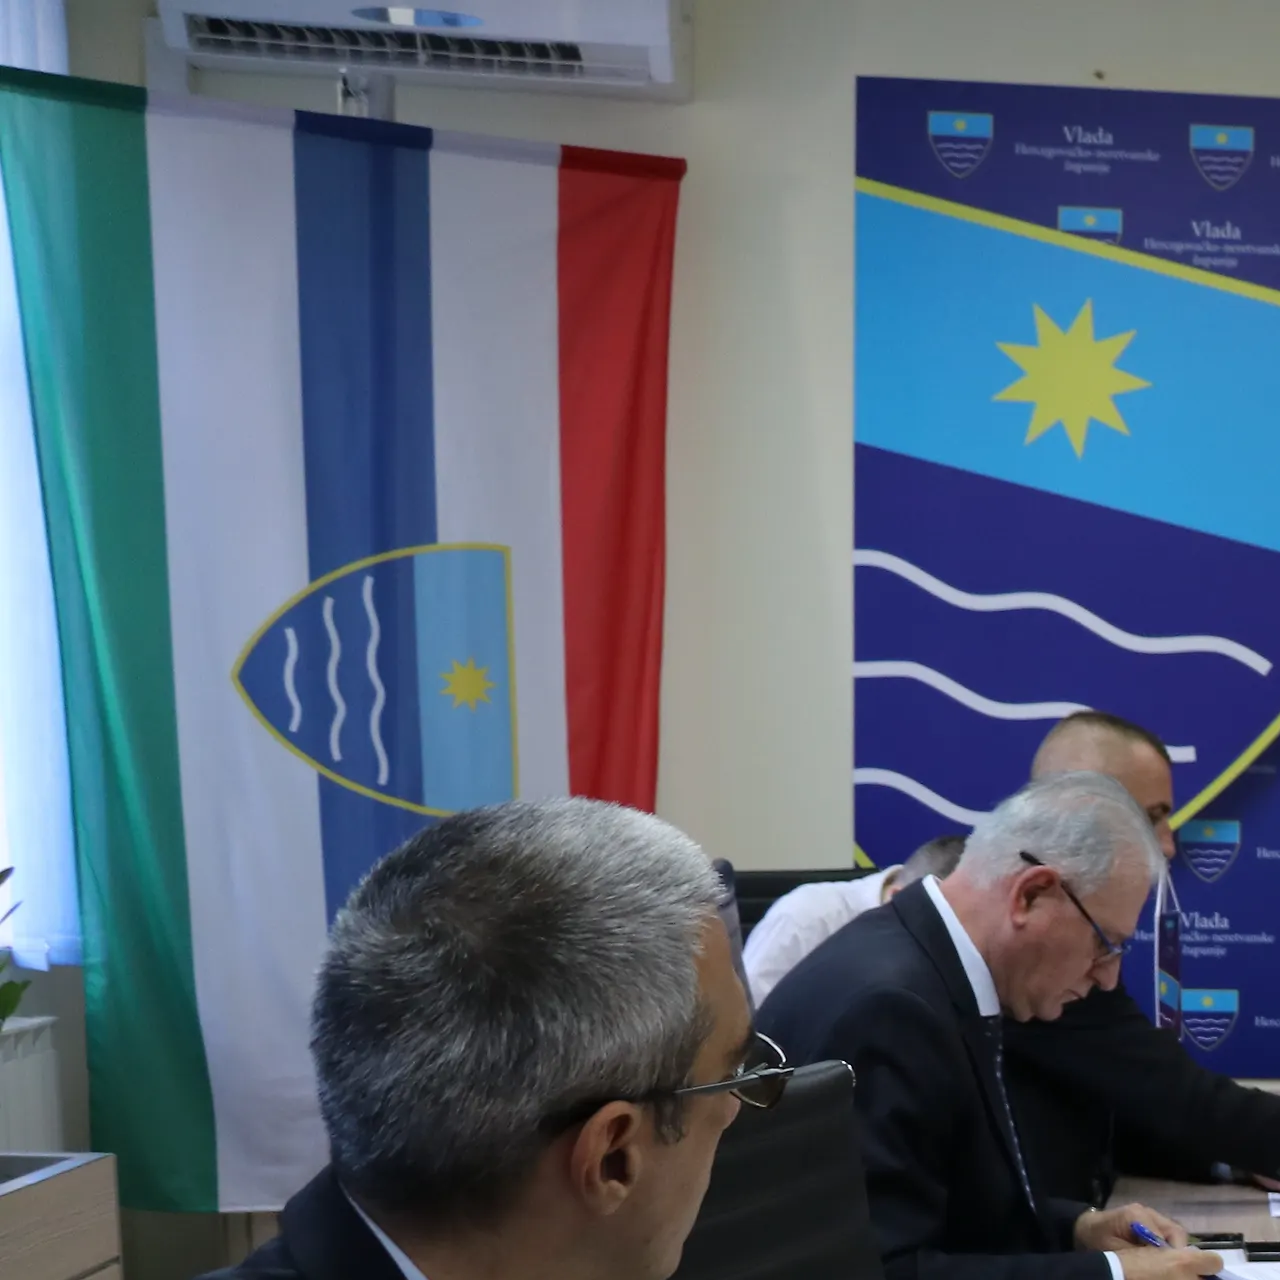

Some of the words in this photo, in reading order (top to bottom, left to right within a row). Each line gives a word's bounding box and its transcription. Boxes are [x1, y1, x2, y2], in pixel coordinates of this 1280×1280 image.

[1062, 124, 1114, 145] Vlada
[1191, 218, 1242, 239] Vlada
[1180, 911, 1230, 929] Vlada
